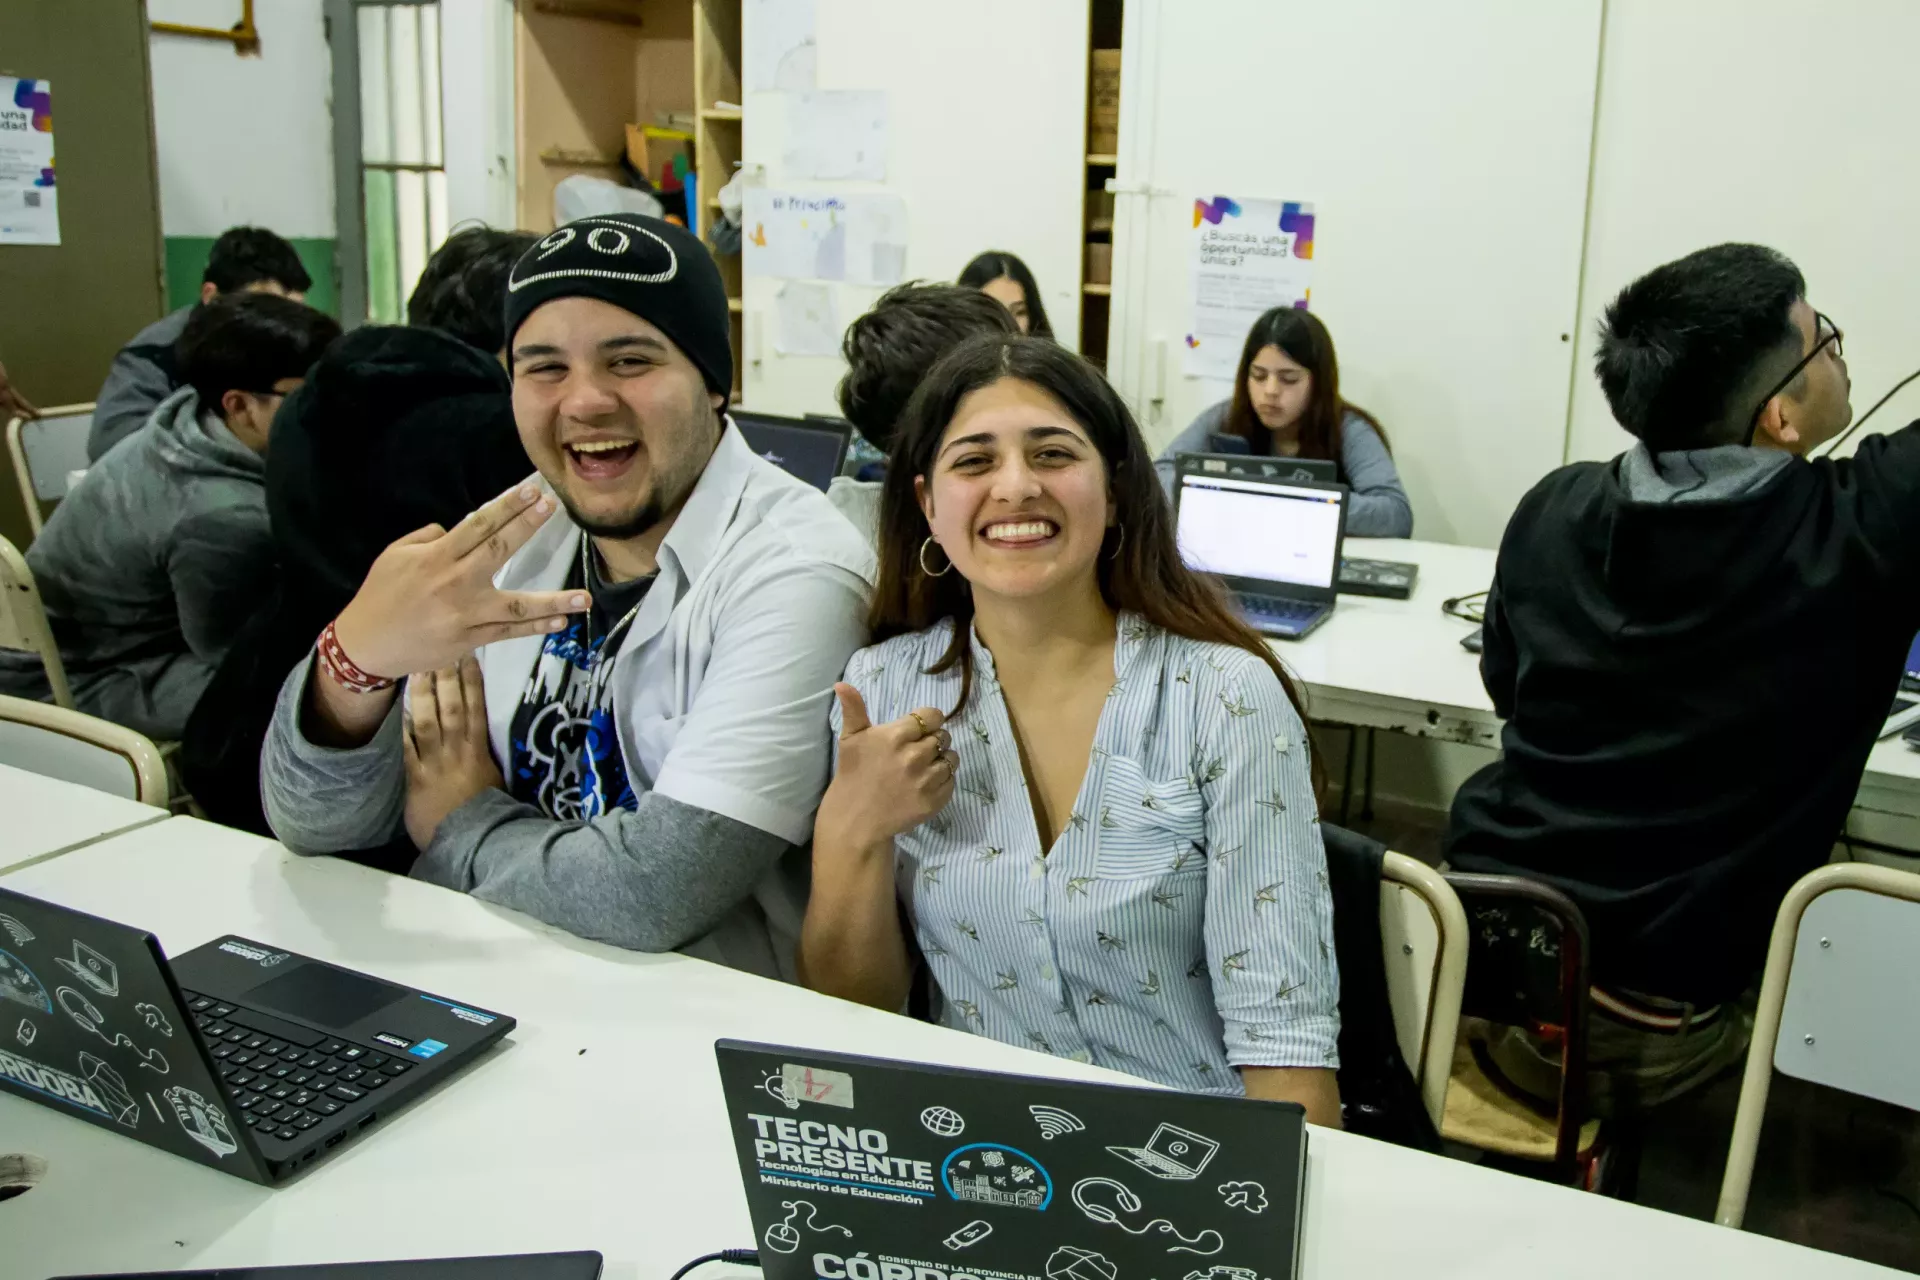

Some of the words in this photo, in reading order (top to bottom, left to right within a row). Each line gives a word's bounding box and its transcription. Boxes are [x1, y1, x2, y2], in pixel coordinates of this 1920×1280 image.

[1, 111, 27, 121] una
[1200, 242, 1288, 258] oportunidad
[1262, 234, 1289, 245] una
[0, 1053, 109, 1113] RDOBA
[747, 1112, 888, 1154] TECNO
[754, 1138, 934, 1182] PRESENTE
[756, 1159, 840, 1178] Tecnologías
[841, 1171, 860, 1181] en
[861, 1173, 935, 1191] Educación
[760, 1175, 832, 1192] Ministerio
[833, 1182, 849, 1195] de
[850, 1187, 923, 1205] Educación
[878, 1254, 933, 1269] GOBIERNO
[935, 1262, 950, 1271] DE
[951, 1265, 965, 1274] LA
[966, 1267, 1026, 1280] PROVINCIA
